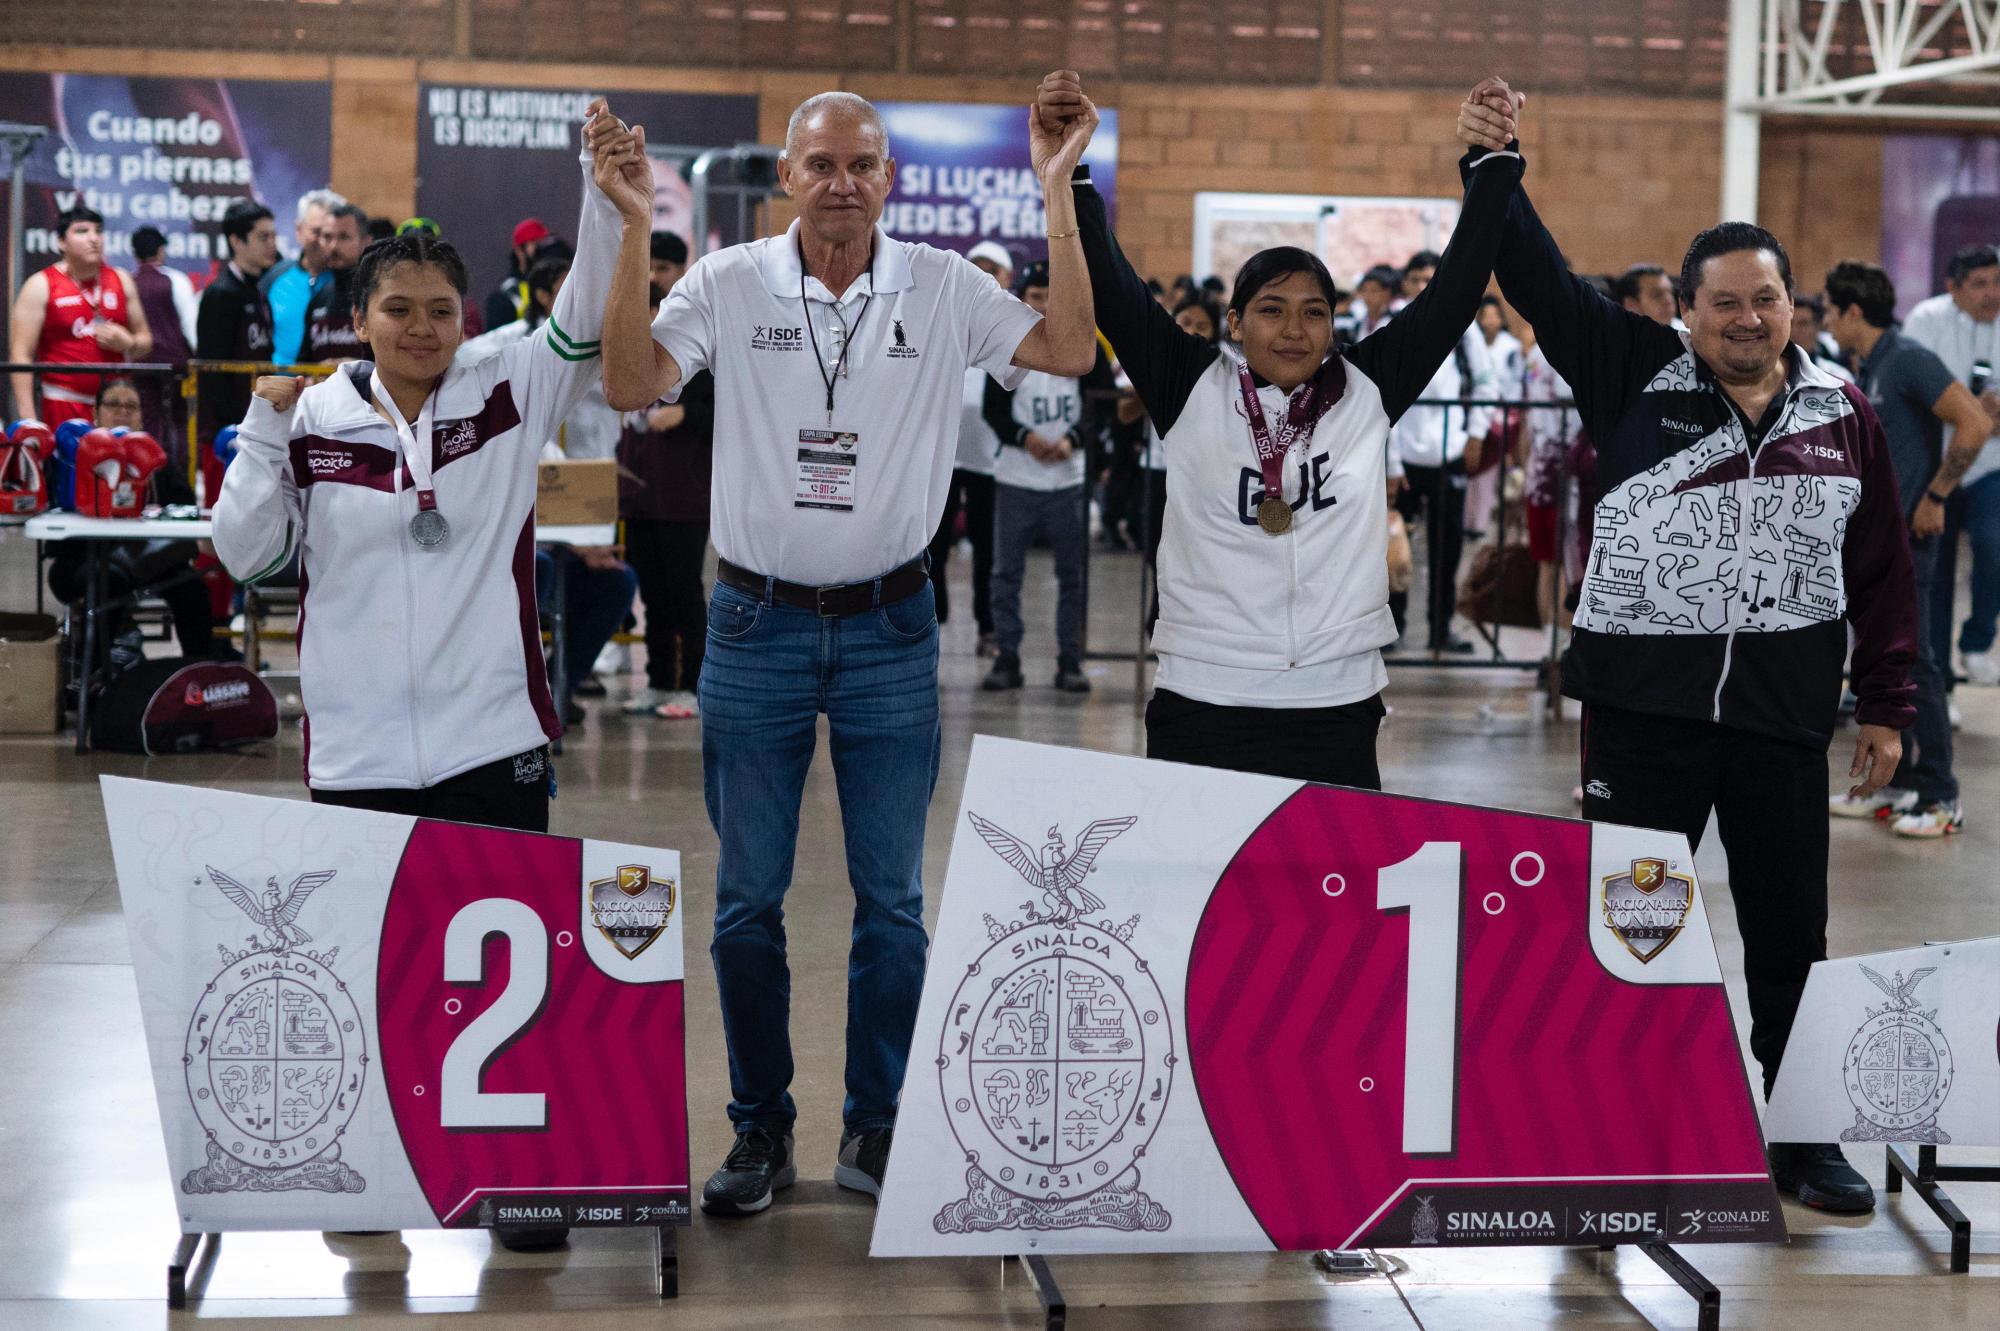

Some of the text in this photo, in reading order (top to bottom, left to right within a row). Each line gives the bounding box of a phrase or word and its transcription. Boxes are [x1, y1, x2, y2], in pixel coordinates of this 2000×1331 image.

[428, 88, 598, 122] NO ES MOTIVACIÓ
[88, 110, 222, 145] Cuando
[434, 116, 571, 149] ES DISCIPLINA
[55, 147, 252, 187] tus piernas
[901, 163, 1044, 199] SI LUCHA
[84, 187, 122, 218] tu
[129, 187, 229, 221] cabez
[882, 202, 1048, 239] UEDES PER
[769, 327, 802, 340] ISDE
[888, 346, 917, 354] SINALOA
[1247, 391, 1260, 417] SINALOA
[1660, 417, 1704, 434] SINALOA
[1279, 423, 1298, 447] ISDE
[1256, 436, 1274, 460] ISDE
[1815, 445, 1845, 462] ISDE
[308, 456, 353, 470] eporte
[514, 760, 545, 778] AHOME
[591, 901, 671, 913] NACIONALES
[1603, 898, 1689, 912] NACIONALES
[592, 911, 669, 928] CONADE
[1603, 911, 1687, 928] CONADE
[615, 928, 648, 937] 2024
[1628, 929, 1663, 938] 2024
[1011, 933, 1112, 960] SINALOA
[239, 960, 318, 981] SINALOA
[1376, 841, 1461, 1153] 1
[440, 897, 548, 1127] 2
[1877, 1014, 1925, 1028] SINALOA
[252, 1146, 298, 1160] 1831
[1025, 1172, 1083, 1189] 1831
[498, 1205, 689, 1221] SINALOA ISDE CONADE
[1447, 1210, 1770, 1233] SINALOA ISDE CONADE
[1446, 1231, 1495, 1239] GOBIERNO
